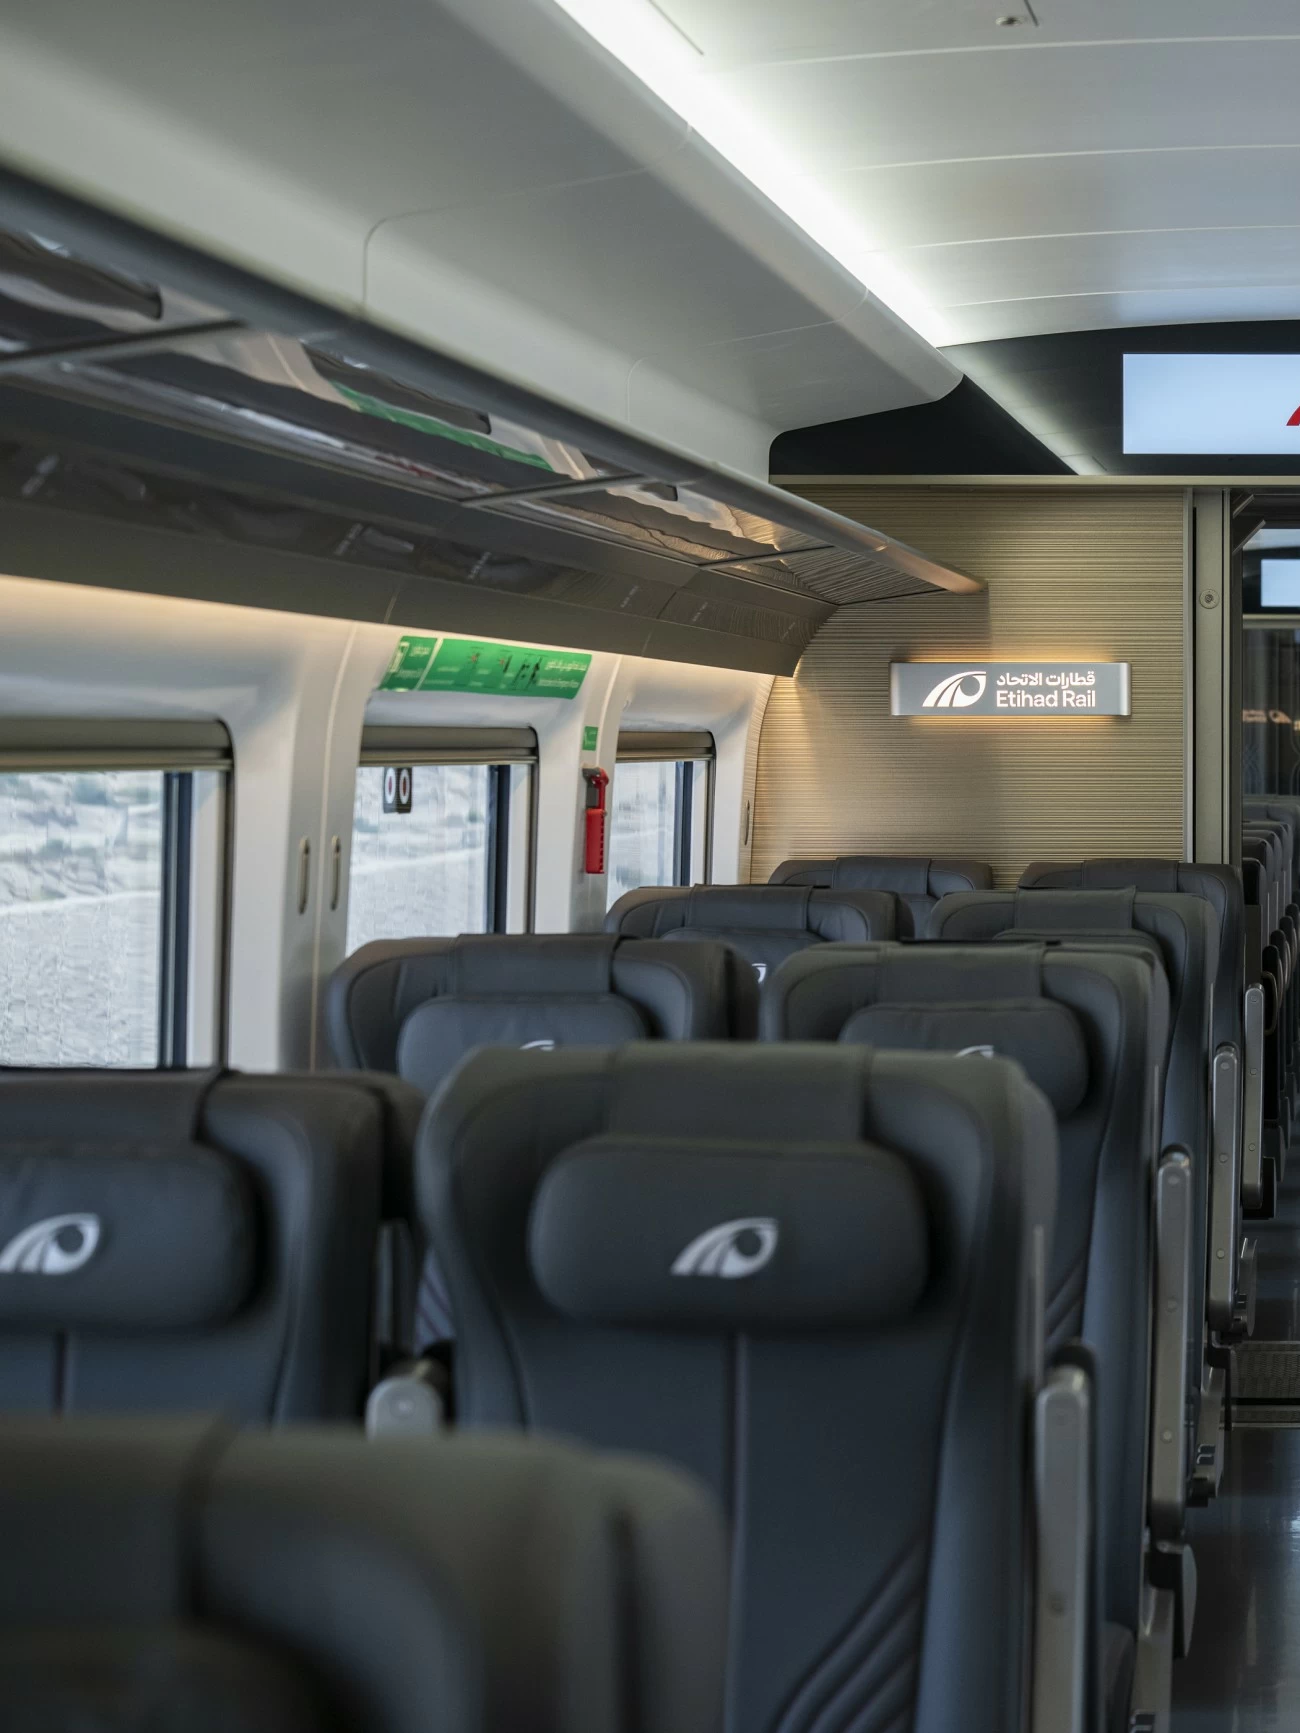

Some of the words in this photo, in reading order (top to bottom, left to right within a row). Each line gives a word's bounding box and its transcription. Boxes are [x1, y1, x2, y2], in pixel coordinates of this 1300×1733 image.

[996, 672, 1043, 687] الاتحاد
[1045, 670, 1096, 690] قطارات
[996, 689, 1059, 708] Etihad
[1062, 689, 1096, 708] Rail
